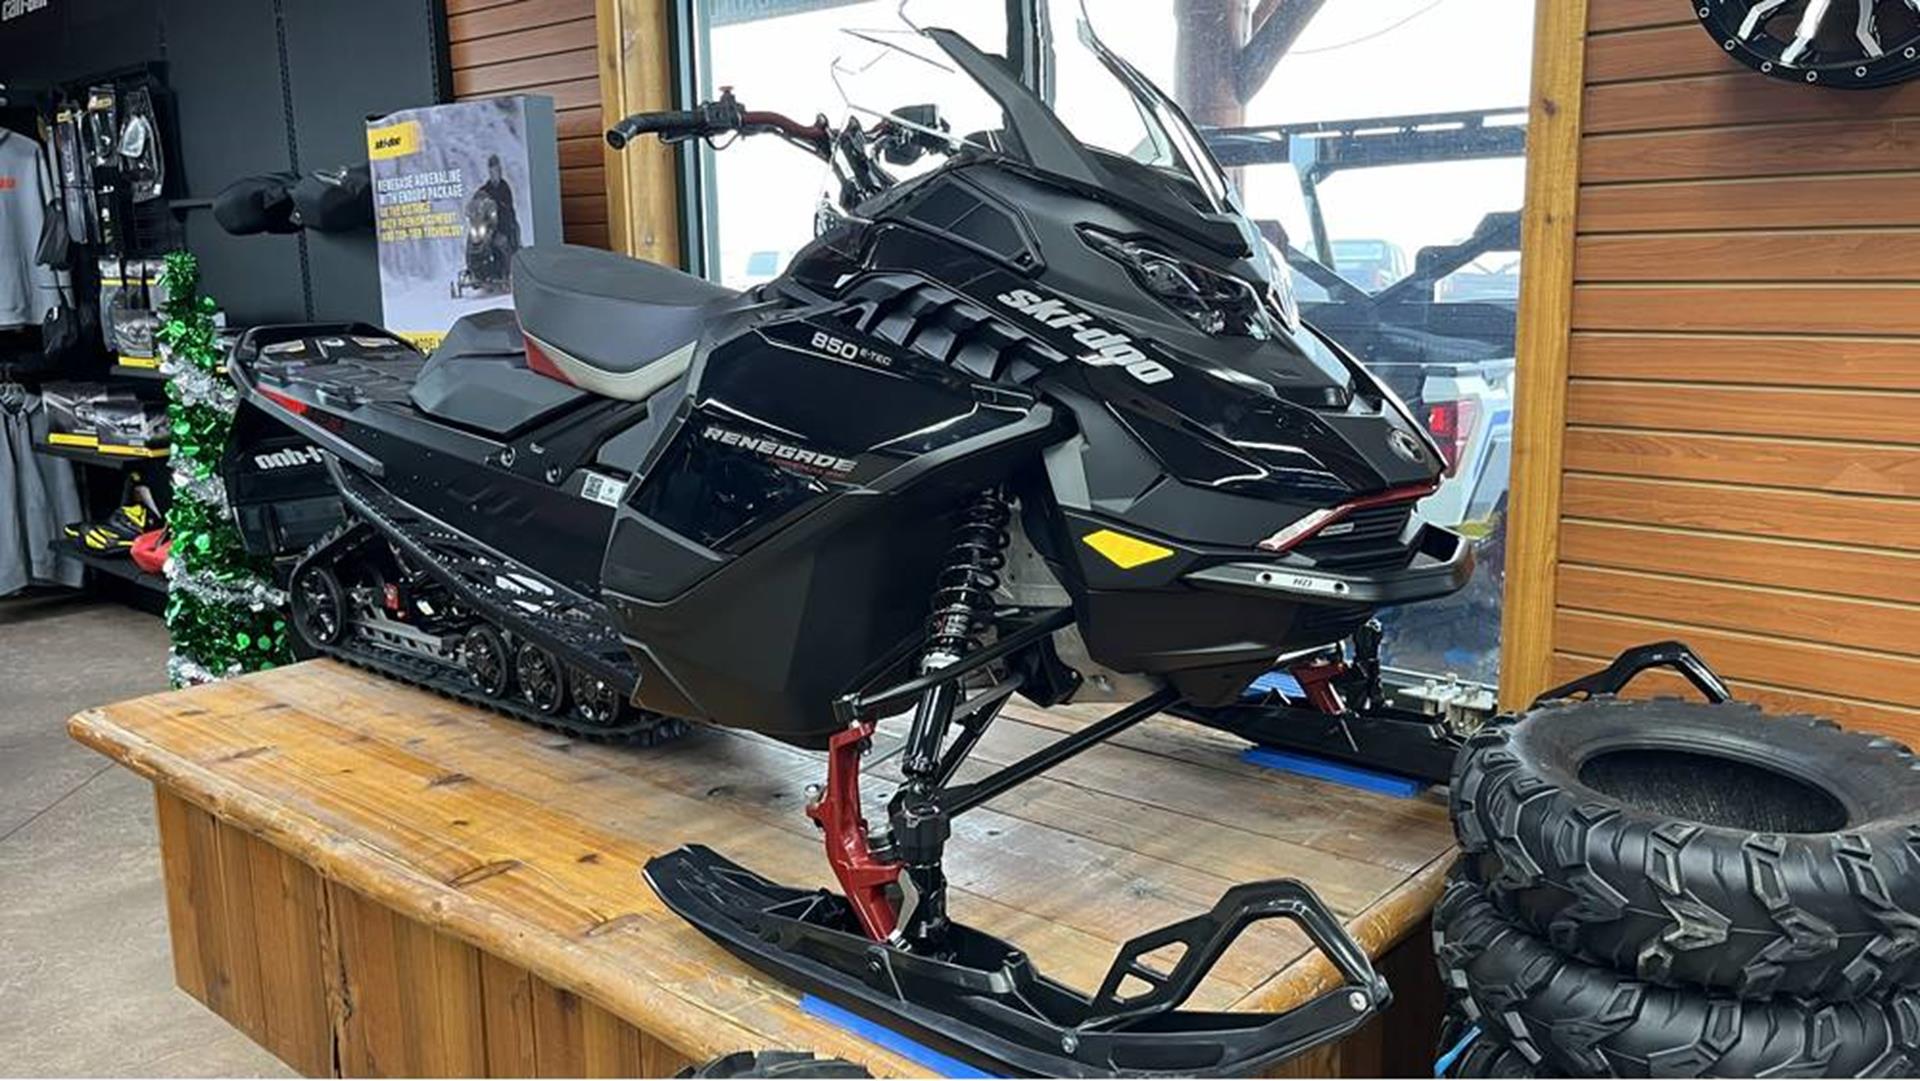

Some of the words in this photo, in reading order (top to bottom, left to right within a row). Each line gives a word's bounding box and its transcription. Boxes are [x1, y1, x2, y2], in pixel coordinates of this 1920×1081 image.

[378, 175, 413, 190] RENEGADE
[414, 168, 461, 185] ADRENALINE
[428, 183, 463, 198] PACKAGE
[811, 331, 858, 360] 850
[860, 347, 892, 366] E-TEC
[703, 426, 858, 472] RENEGADE
